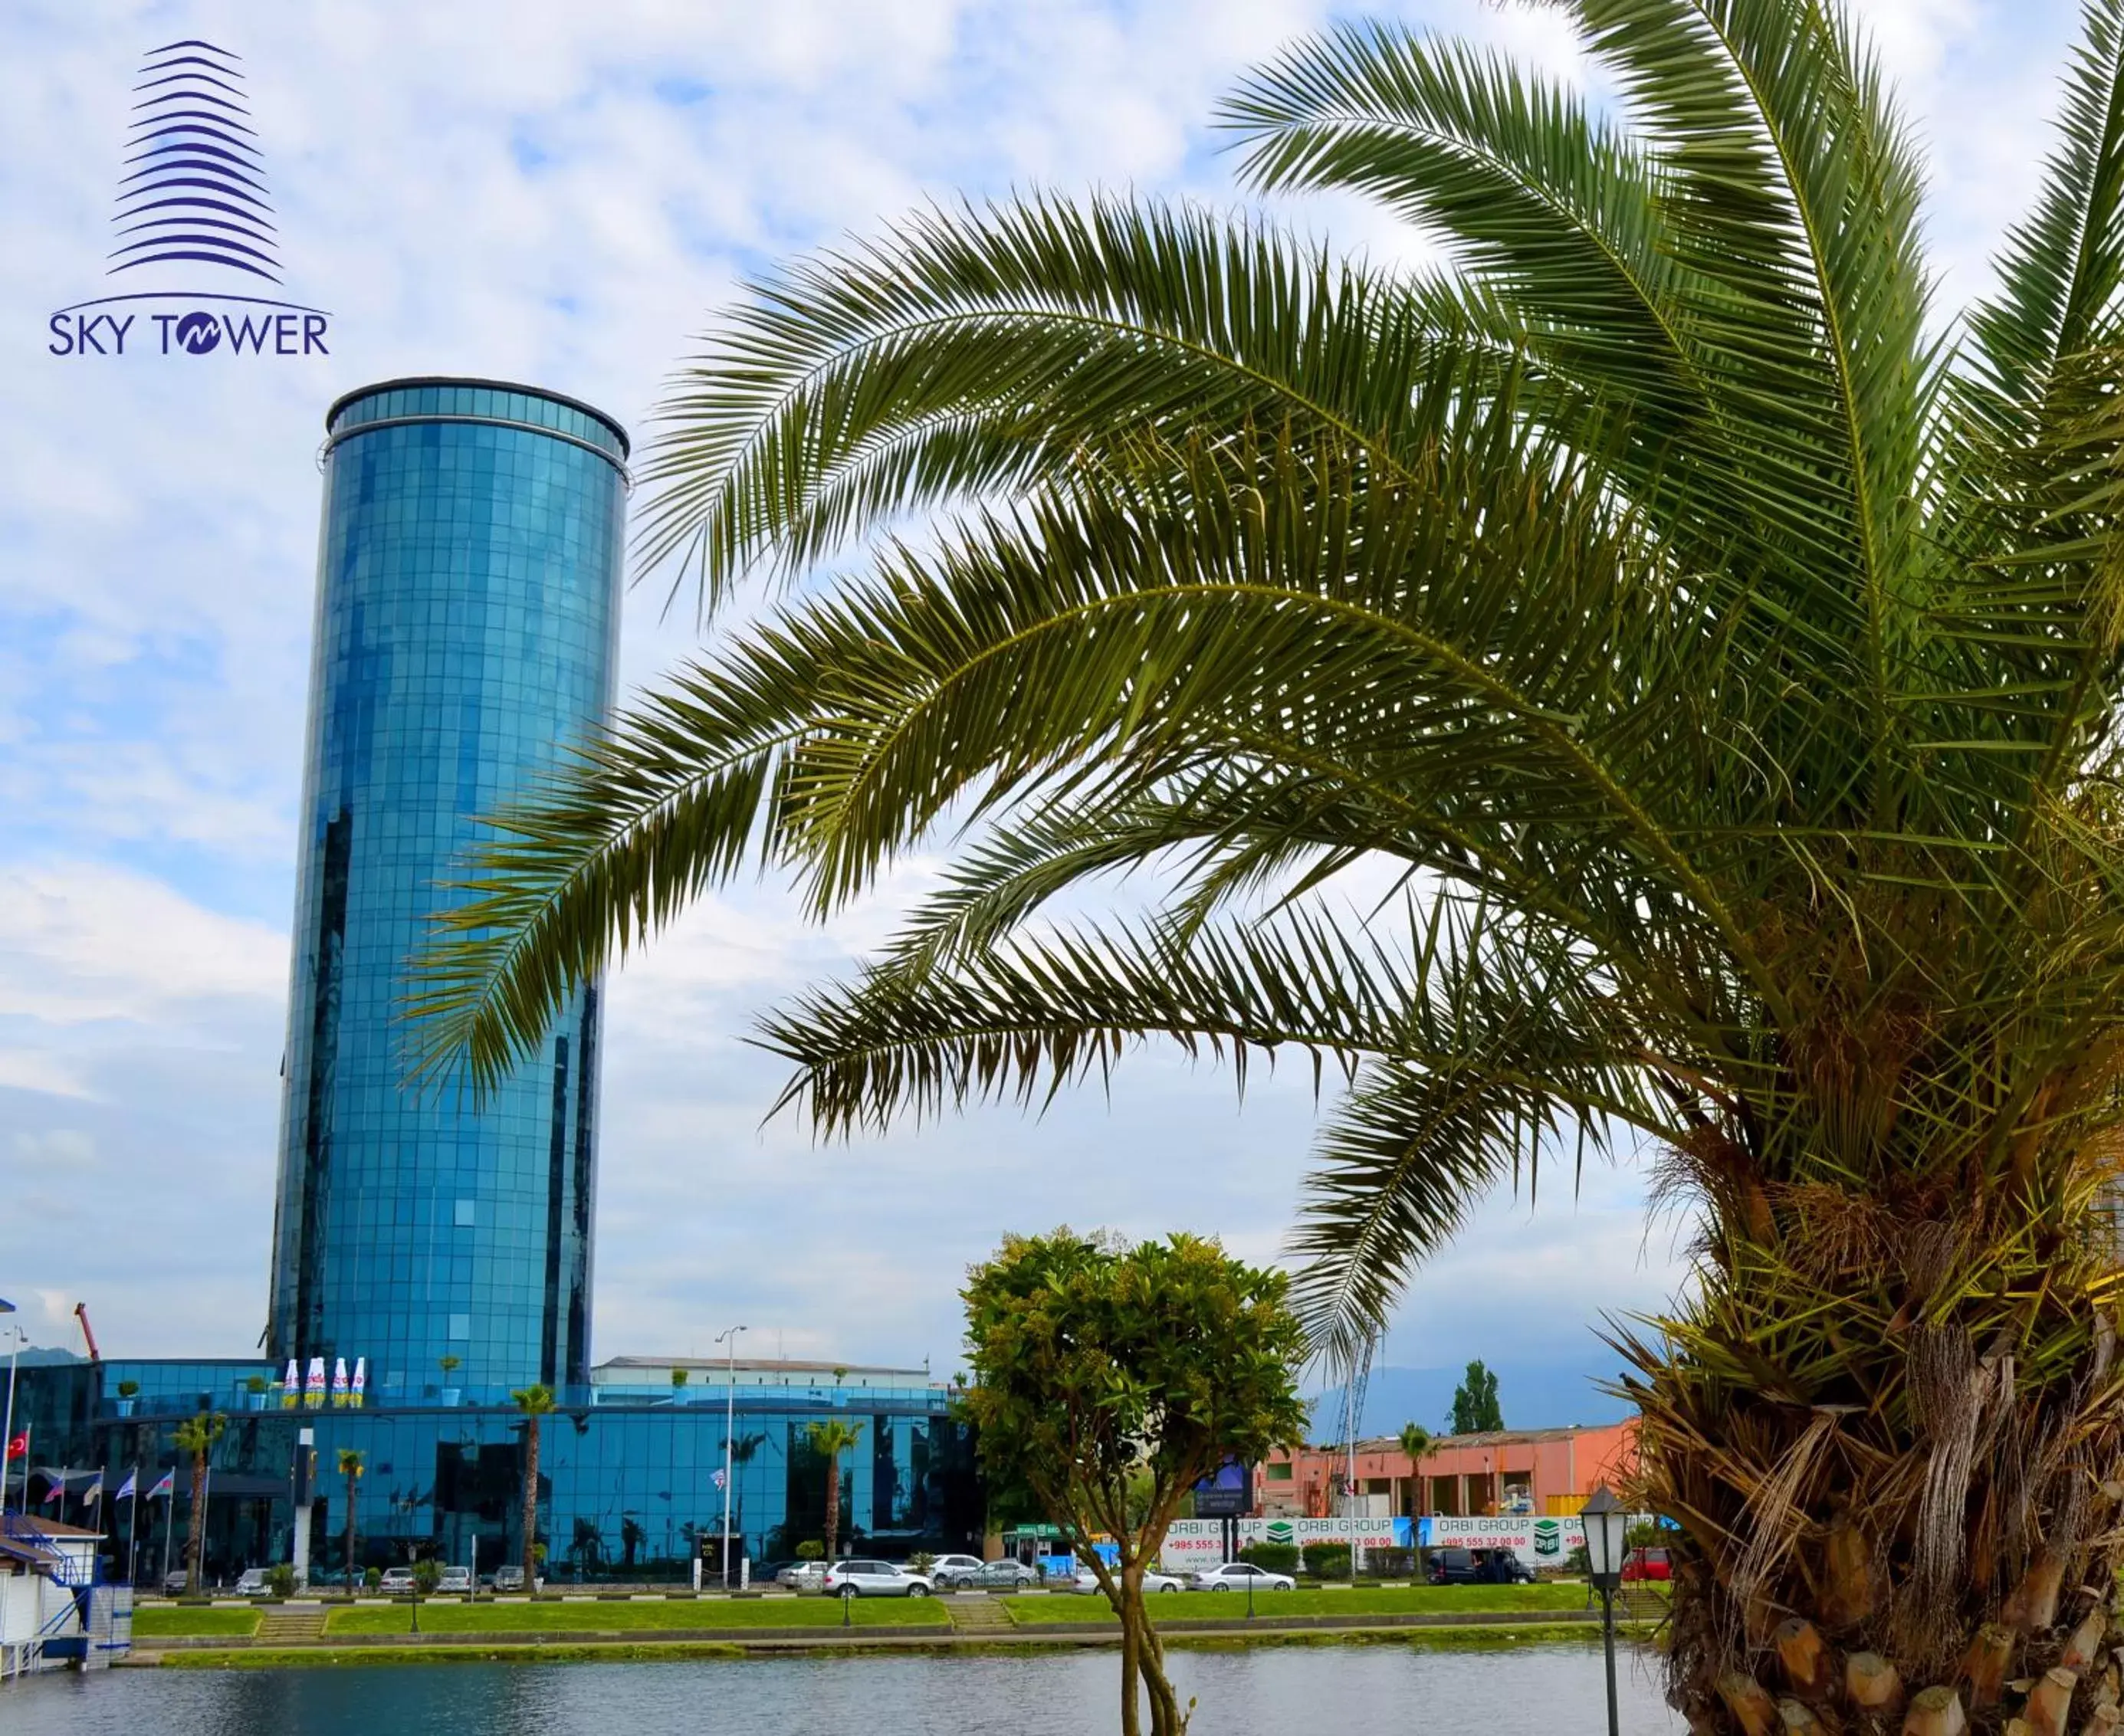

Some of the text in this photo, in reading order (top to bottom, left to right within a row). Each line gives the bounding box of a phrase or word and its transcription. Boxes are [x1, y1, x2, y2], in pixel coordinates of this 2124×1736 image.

[1168, 1521, 1203, 1534] ORBI
[1298, 1519, 1391, 1532] ORBI GROUP
[1440, 1519, 1530, 1531] ORBI GROUP
[1196, 1540, 1214, 1550] 555
[1364, 1537, 1376, 1547] 00
[1379, 1537, 1391, 1547] 00
[1466, 1537, 1483, 1547] 555
[1486, 1537, 1498, 1547] 32
[1500, 1537, 1512, 1547] 00
[1513, 1537, 1526, 1547] 00
